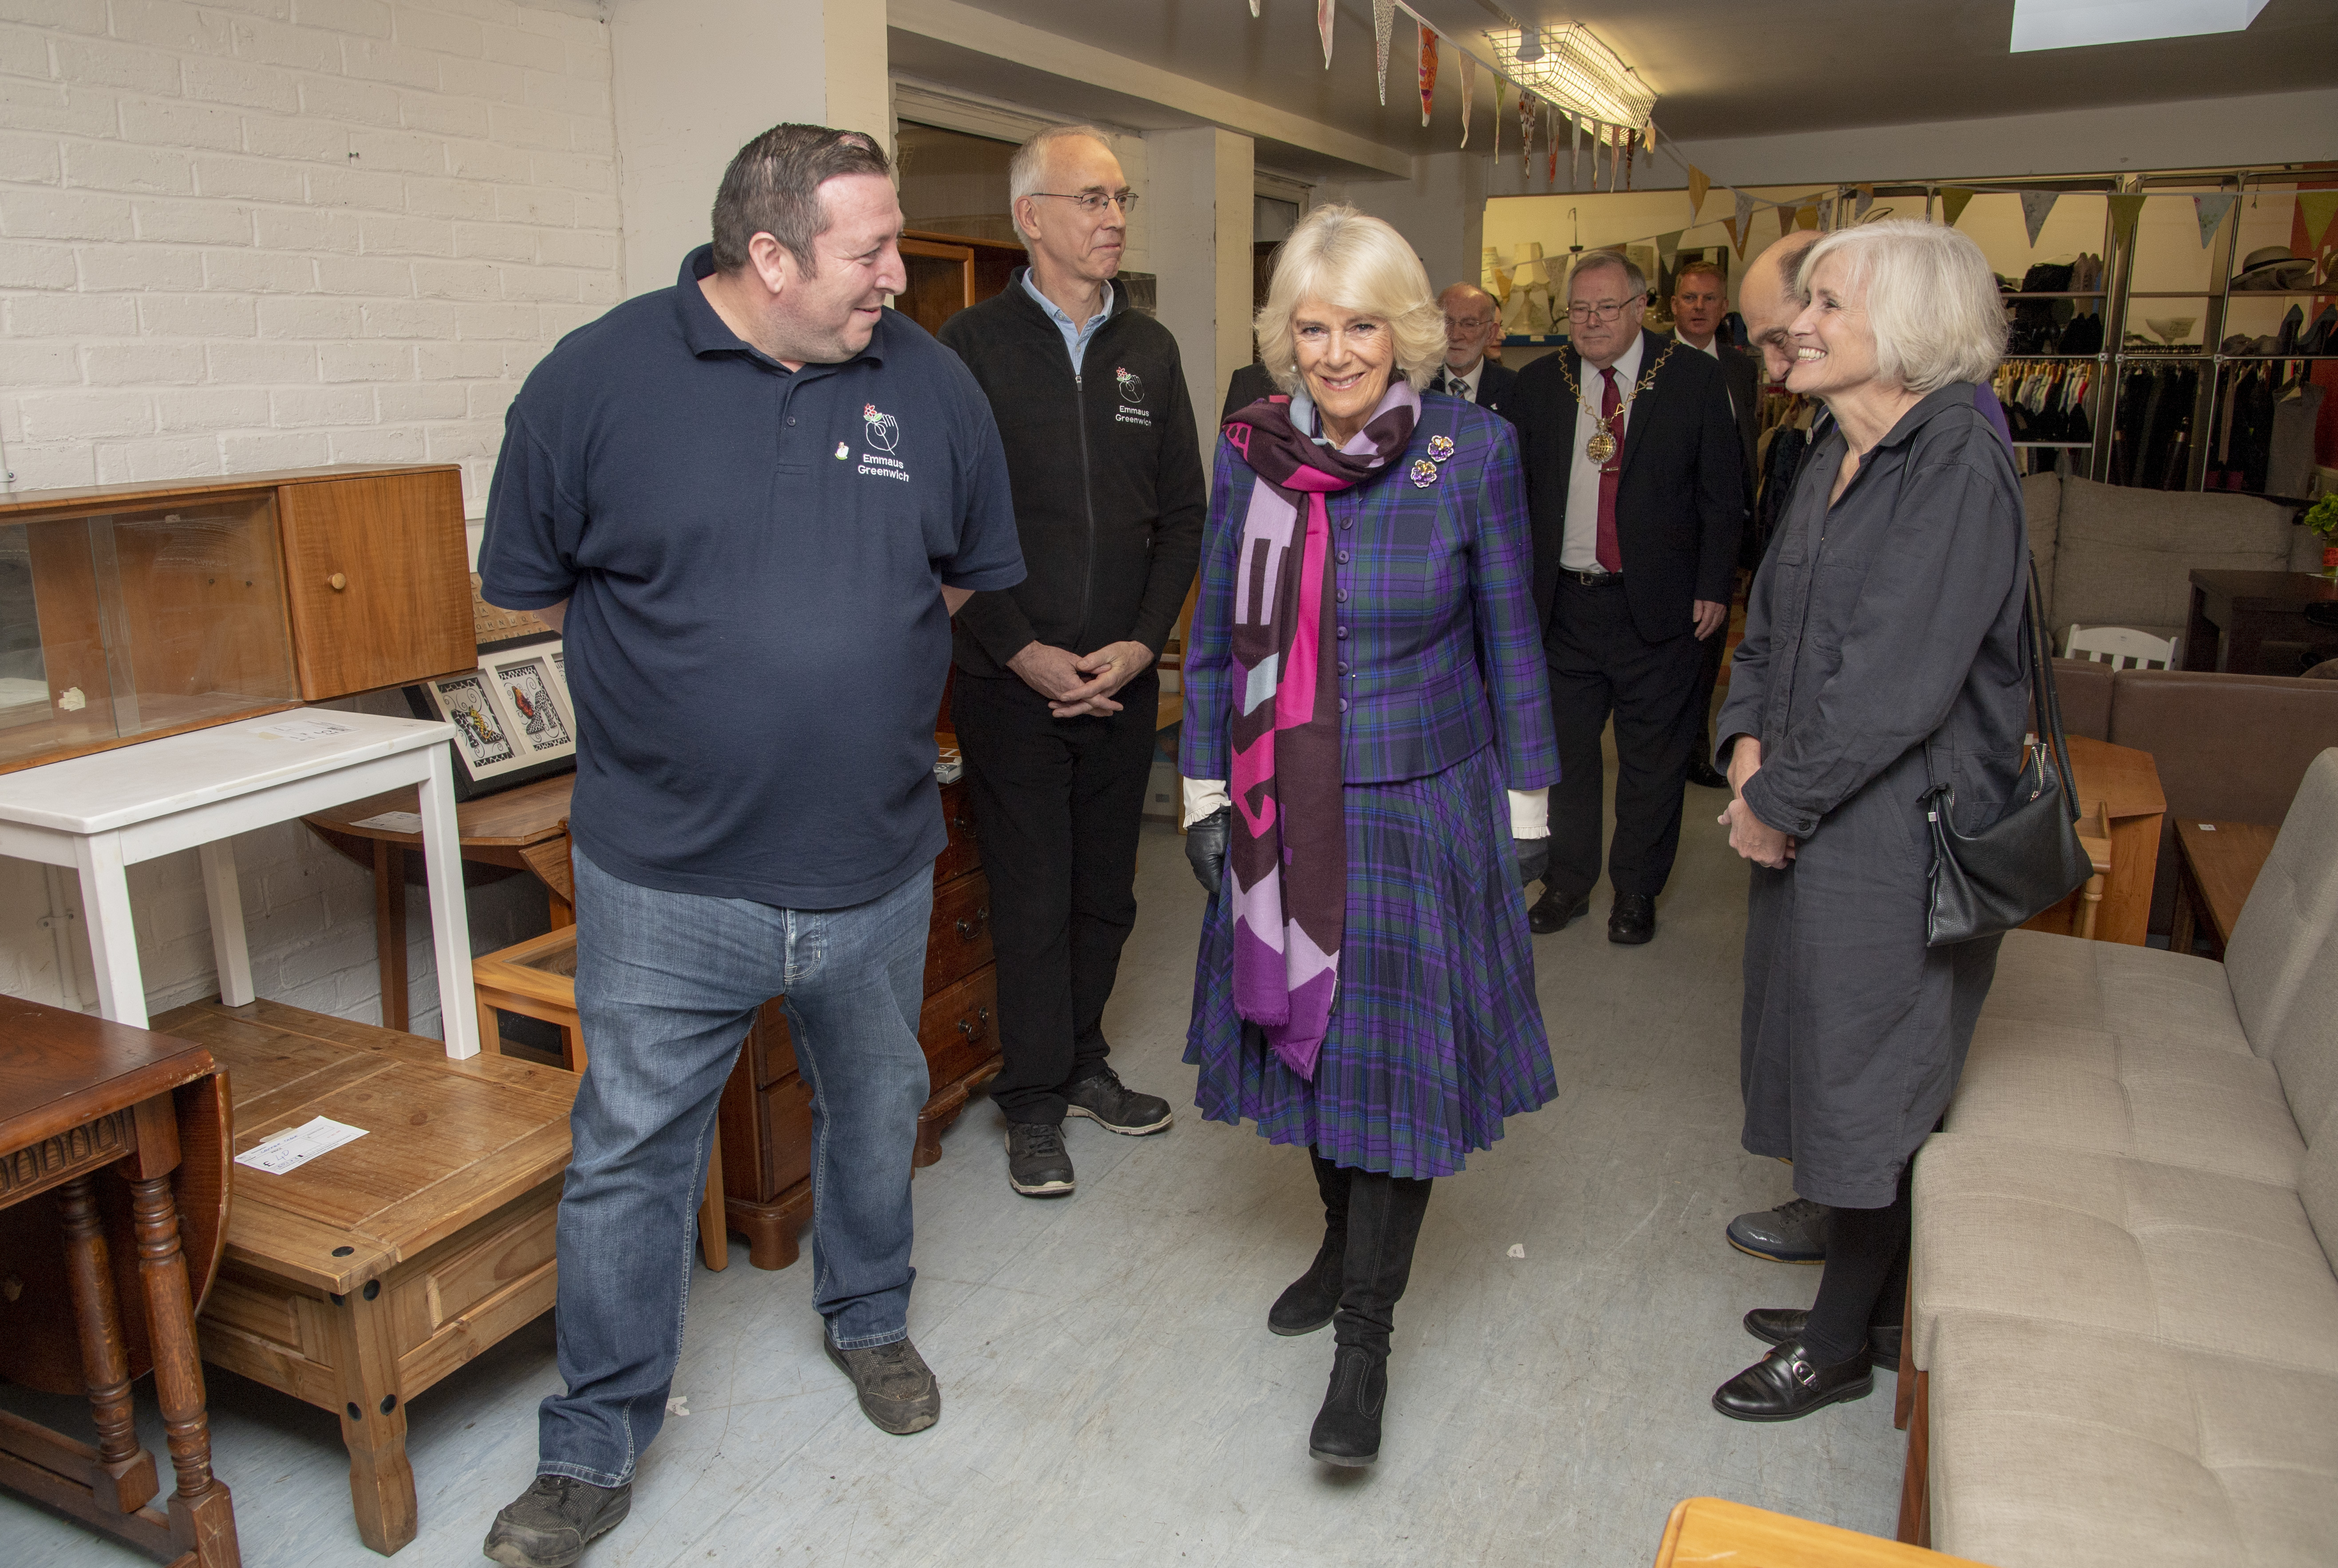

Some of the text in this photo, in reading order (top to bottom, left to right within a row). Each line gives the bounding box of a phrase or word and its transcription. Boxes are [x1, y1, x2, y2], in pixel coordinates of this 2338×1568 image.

[1119, 405, 1149, 417] Emmaus
[1115, 414, 1152, 426] Greenwich
[863, 453, 904, 469] Emmaus
[857, 465, 909, 482] Greenwich
[275, 1150, 289, 1161] 40
